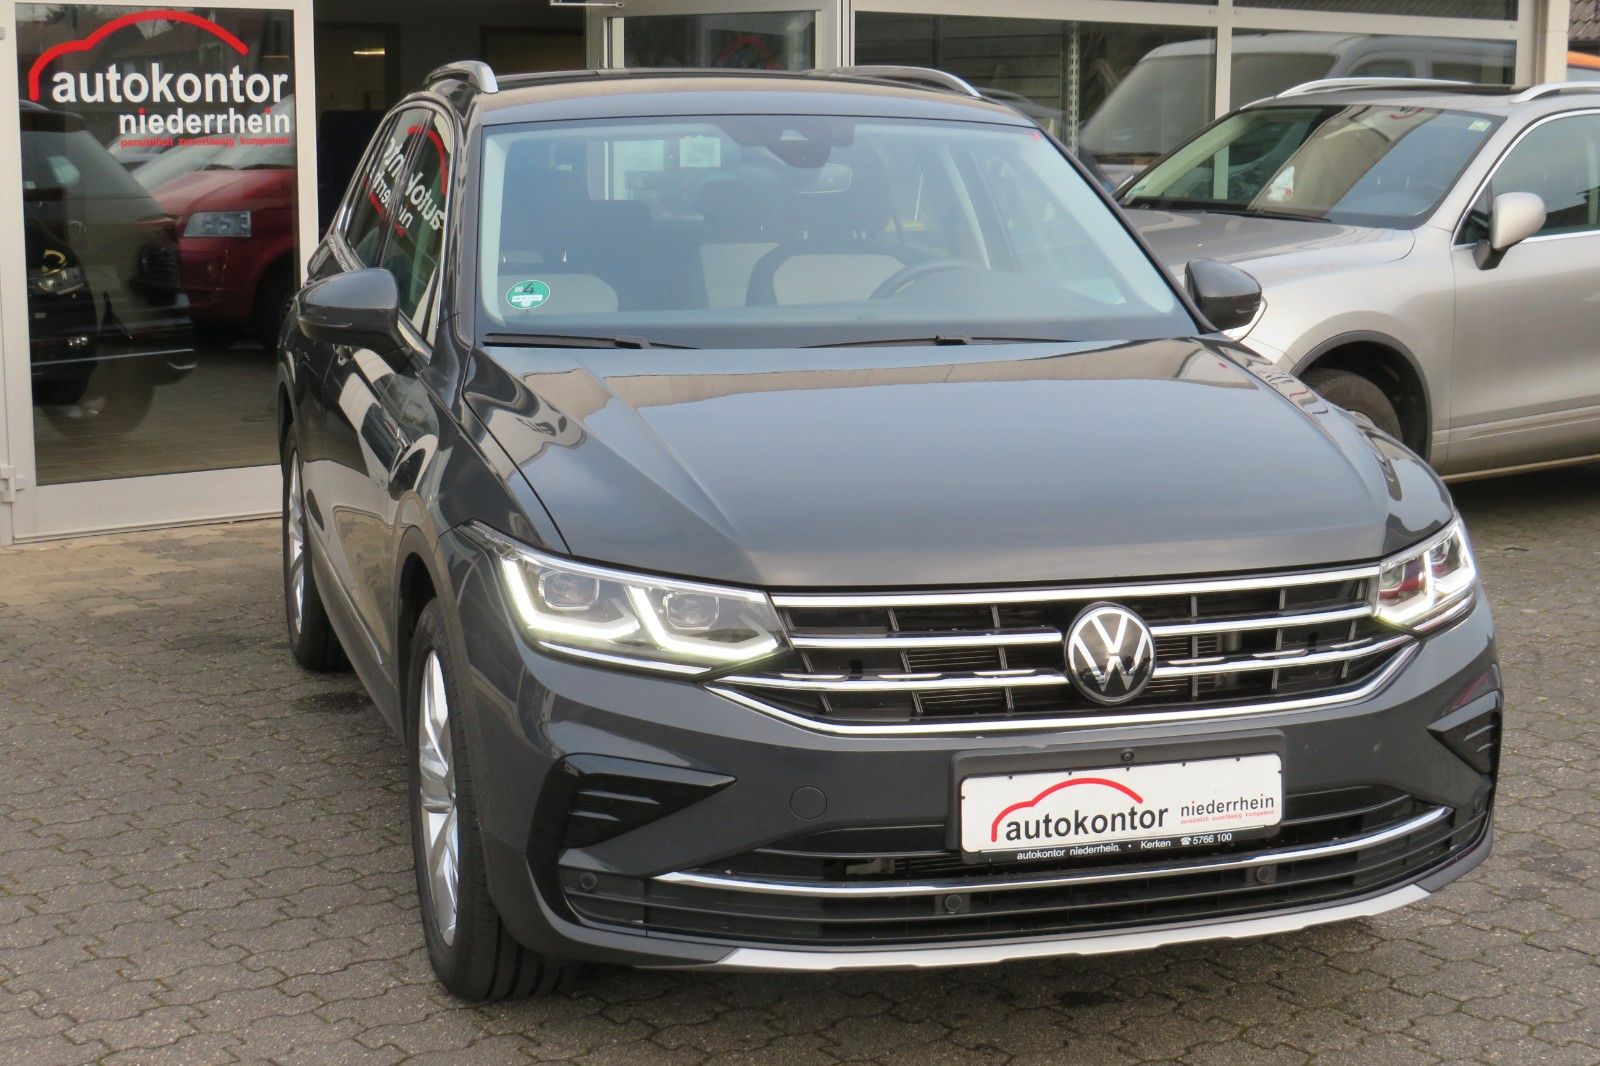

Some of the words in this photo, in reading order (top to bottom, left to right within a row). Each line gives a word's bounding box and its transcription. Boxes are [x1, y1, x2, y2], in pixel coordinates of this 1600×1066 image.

[52, 62, 289, 103] autokontor
[118, 107, 290, 134] niederrhein
[1005, 805, 1169, 841] autokontor
[1180, 793, 1275, 817] niederrhein
[1016, 848, 1066, 861] autokontor
[1140, 839, 1171, 850] Kerken
[1192, 835, 1214, 845] 5766
[1216, 832, 1232, 843] 100
